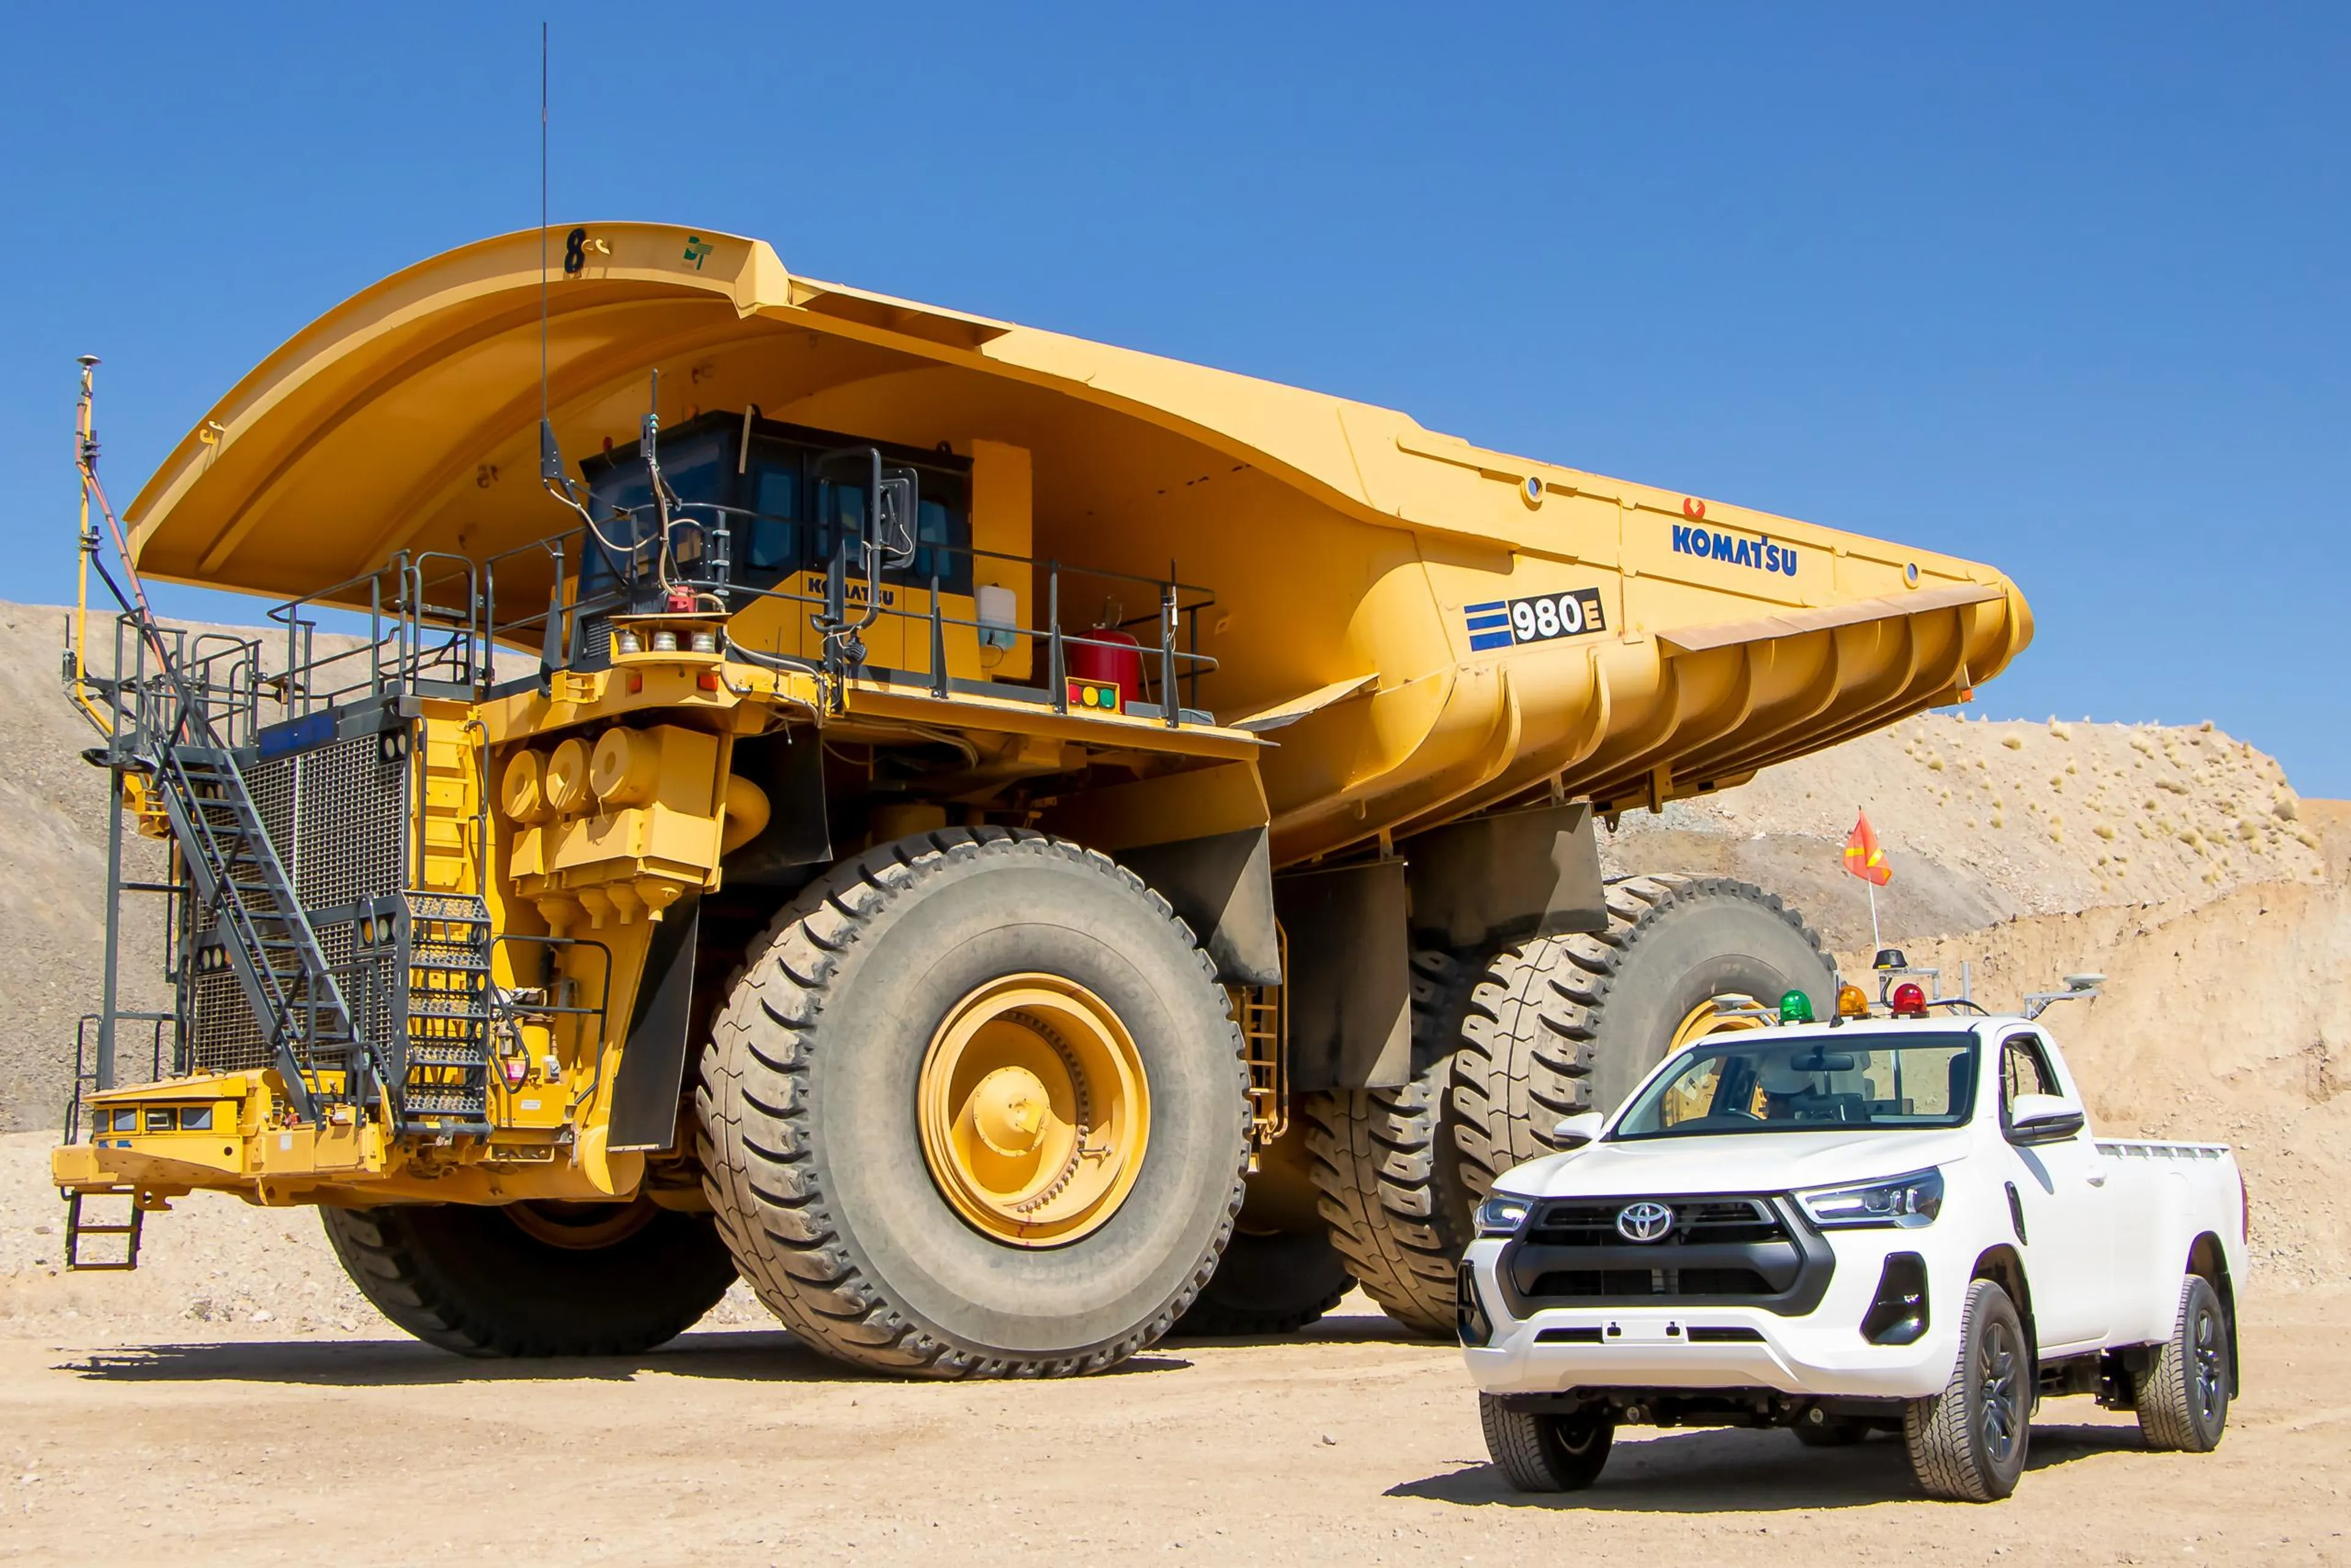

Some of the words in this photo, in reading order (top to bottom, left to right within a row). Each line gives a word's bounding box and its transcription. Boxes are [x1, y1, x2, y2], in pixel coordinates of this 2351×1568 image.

[564, 228, 586, 274] 8
[1673, 524, 1797, 577] KOMATSU
[808, 577, 894, 606] KATU
[1512, 595, 1602, 640] 980E
